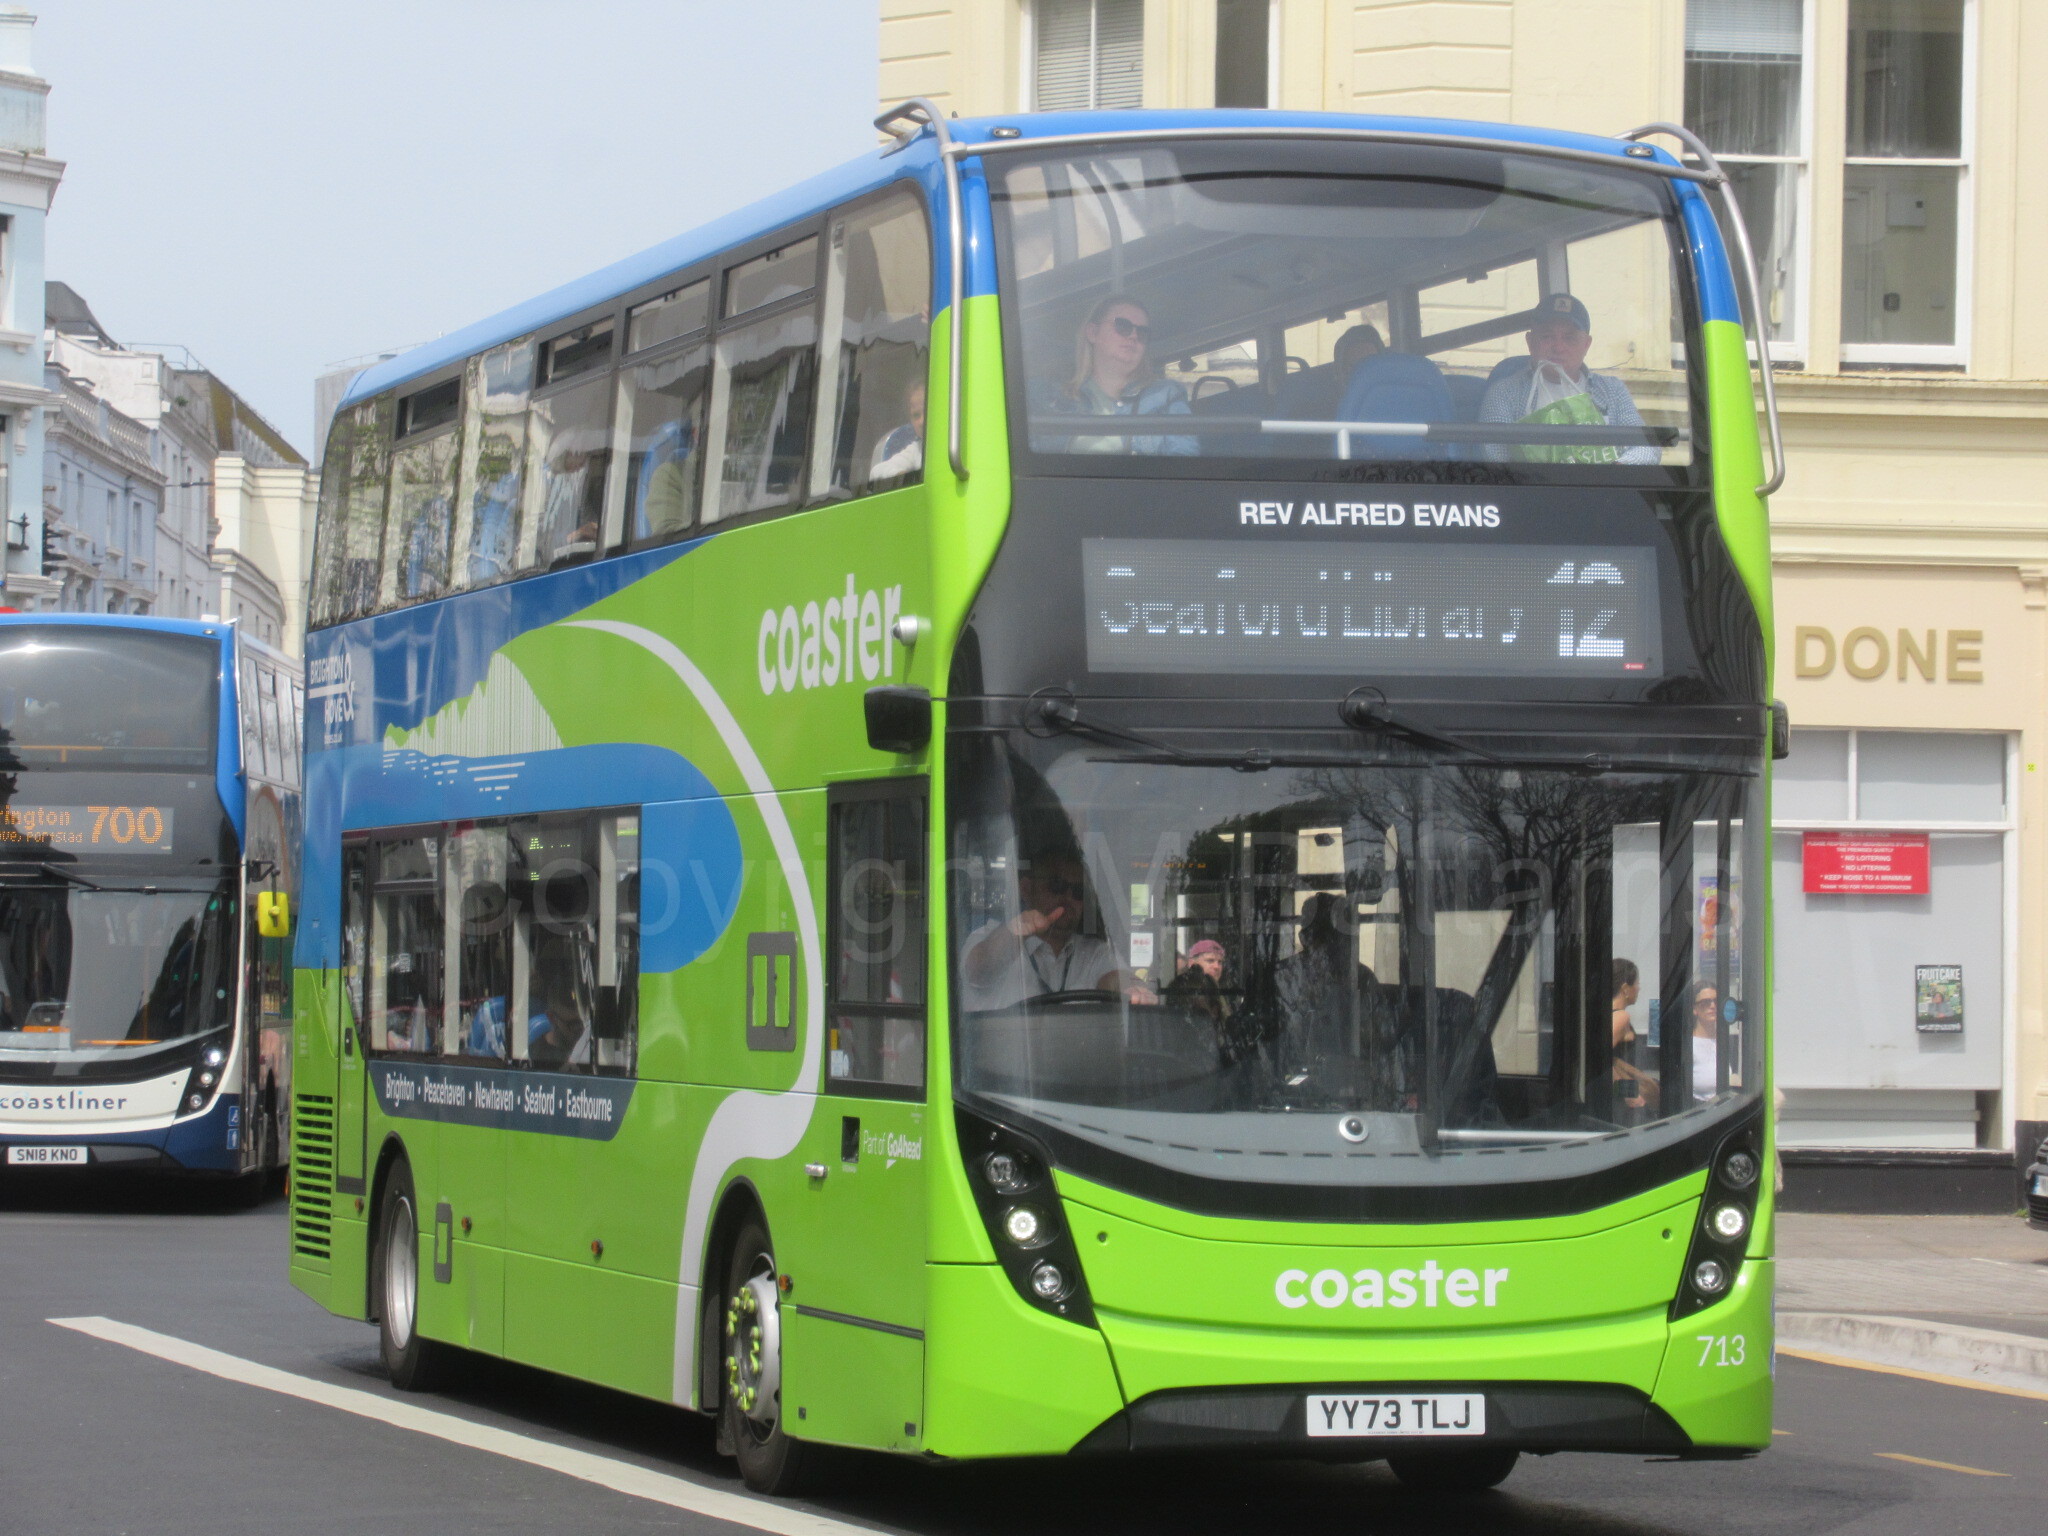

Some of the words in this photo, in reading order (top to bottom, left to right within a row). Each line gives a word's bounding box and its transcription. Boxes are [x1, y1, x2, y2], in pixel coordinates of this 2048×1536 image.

[1240, 503, 1294, 525] REV
[1301, 503, 1406, 526] ALFRED
[1414, 504, 1501, 528] EVANS
[758, 573, 902, 696] coaster
[310, 655, 344, 685] BRIGHTON
[1795, 625, 1984, 684] DONE
[0, 804, 71, 830] ington
[87, 806, 164, 844] 700
[1916, 968, 1961, 981] FRUITCAKE
[0, 1089, 127, 1110] coastliner
[385, 1071, 415, 1108] Brighton
[423, 1076, 466, 1107] Peacehaven
[475, 1081, 514, 1112] Newhaven
[524, 1084, 555, 1116] Seaford
[566, 1088, 612, 1122] Eastbourne
[17, 1148, 47, 1161] SN18
[51, 1148, 78, 1161] KNO
[863, 1129, 878, 1155] Part
[877, 1132, 886, 1156] of
[1275, 1259, 1509, 1309] coaster
[1696, 1334, 1745, 1367] 713
[1320, 1399, 1401, 1430] YY73
[1411, 1399, 1471, 1430] TLJ
